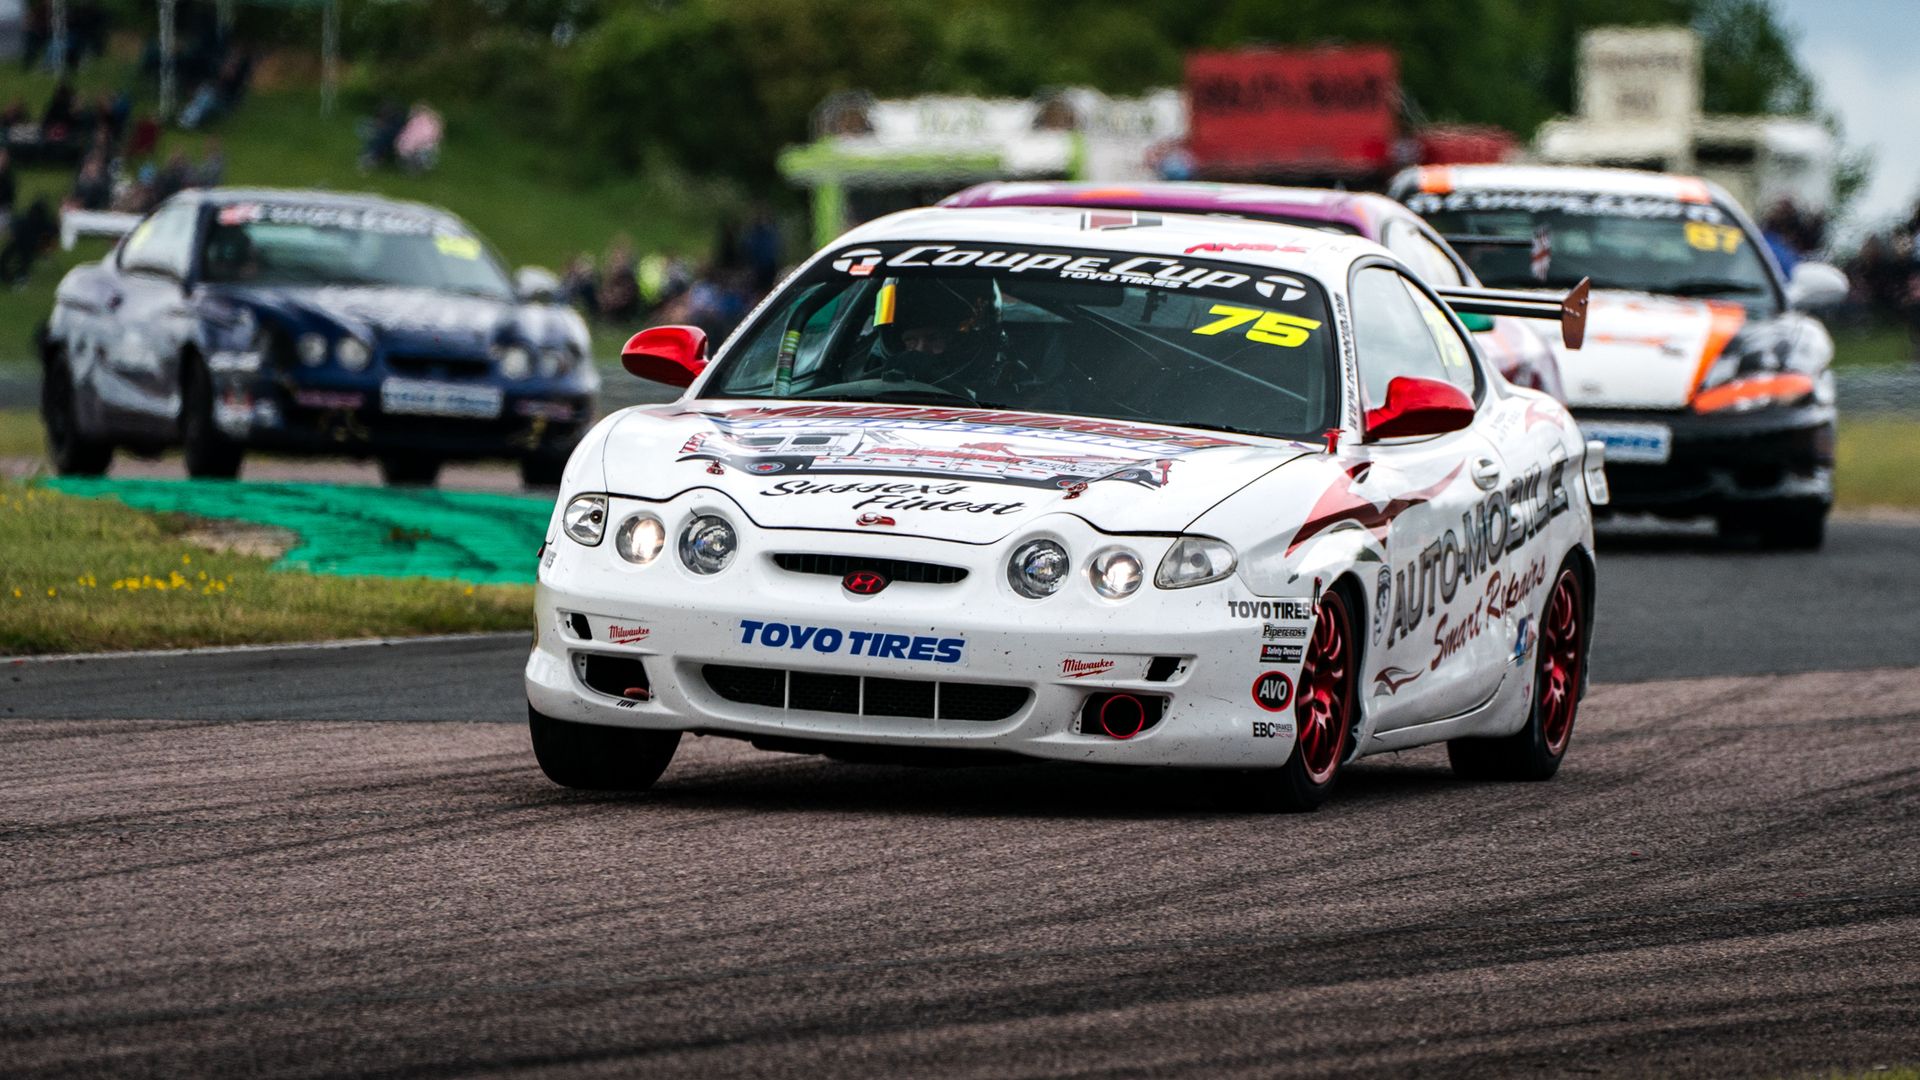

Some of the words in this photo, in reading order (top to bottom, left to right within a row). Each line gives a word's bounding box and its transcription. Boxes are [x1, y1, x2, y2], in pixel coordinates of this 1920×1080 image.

[1060, 270, 1117, 281] TOYO
[1120, 275, 1184, 288] TIRES
[1191, 304, 1322, 348] 75
[852, 494, 1026, 515] Finest
[1228, 601, 1271, 618] TOYO
[1272, 602, 1310, 619] TIRES
[1430, 597, 1482, 671] Smart
[1486, 555, 1546, 629] Repairs
[608, 624, 651, 640] Milwaukee
[1262, 623, 1307, 641] Pipercross
[740, 619, 843, 653] TOYO
[848, 631, 965, 664] TIRES
[1267, 646, 1282, 656] Safety
[1062, 658, 1115, 673] Milwaukee
[1259, 679, 1288, 701] AVO
[616, 699, 639, 709] TOW
[1253, 721, 1275, 739] EBC
